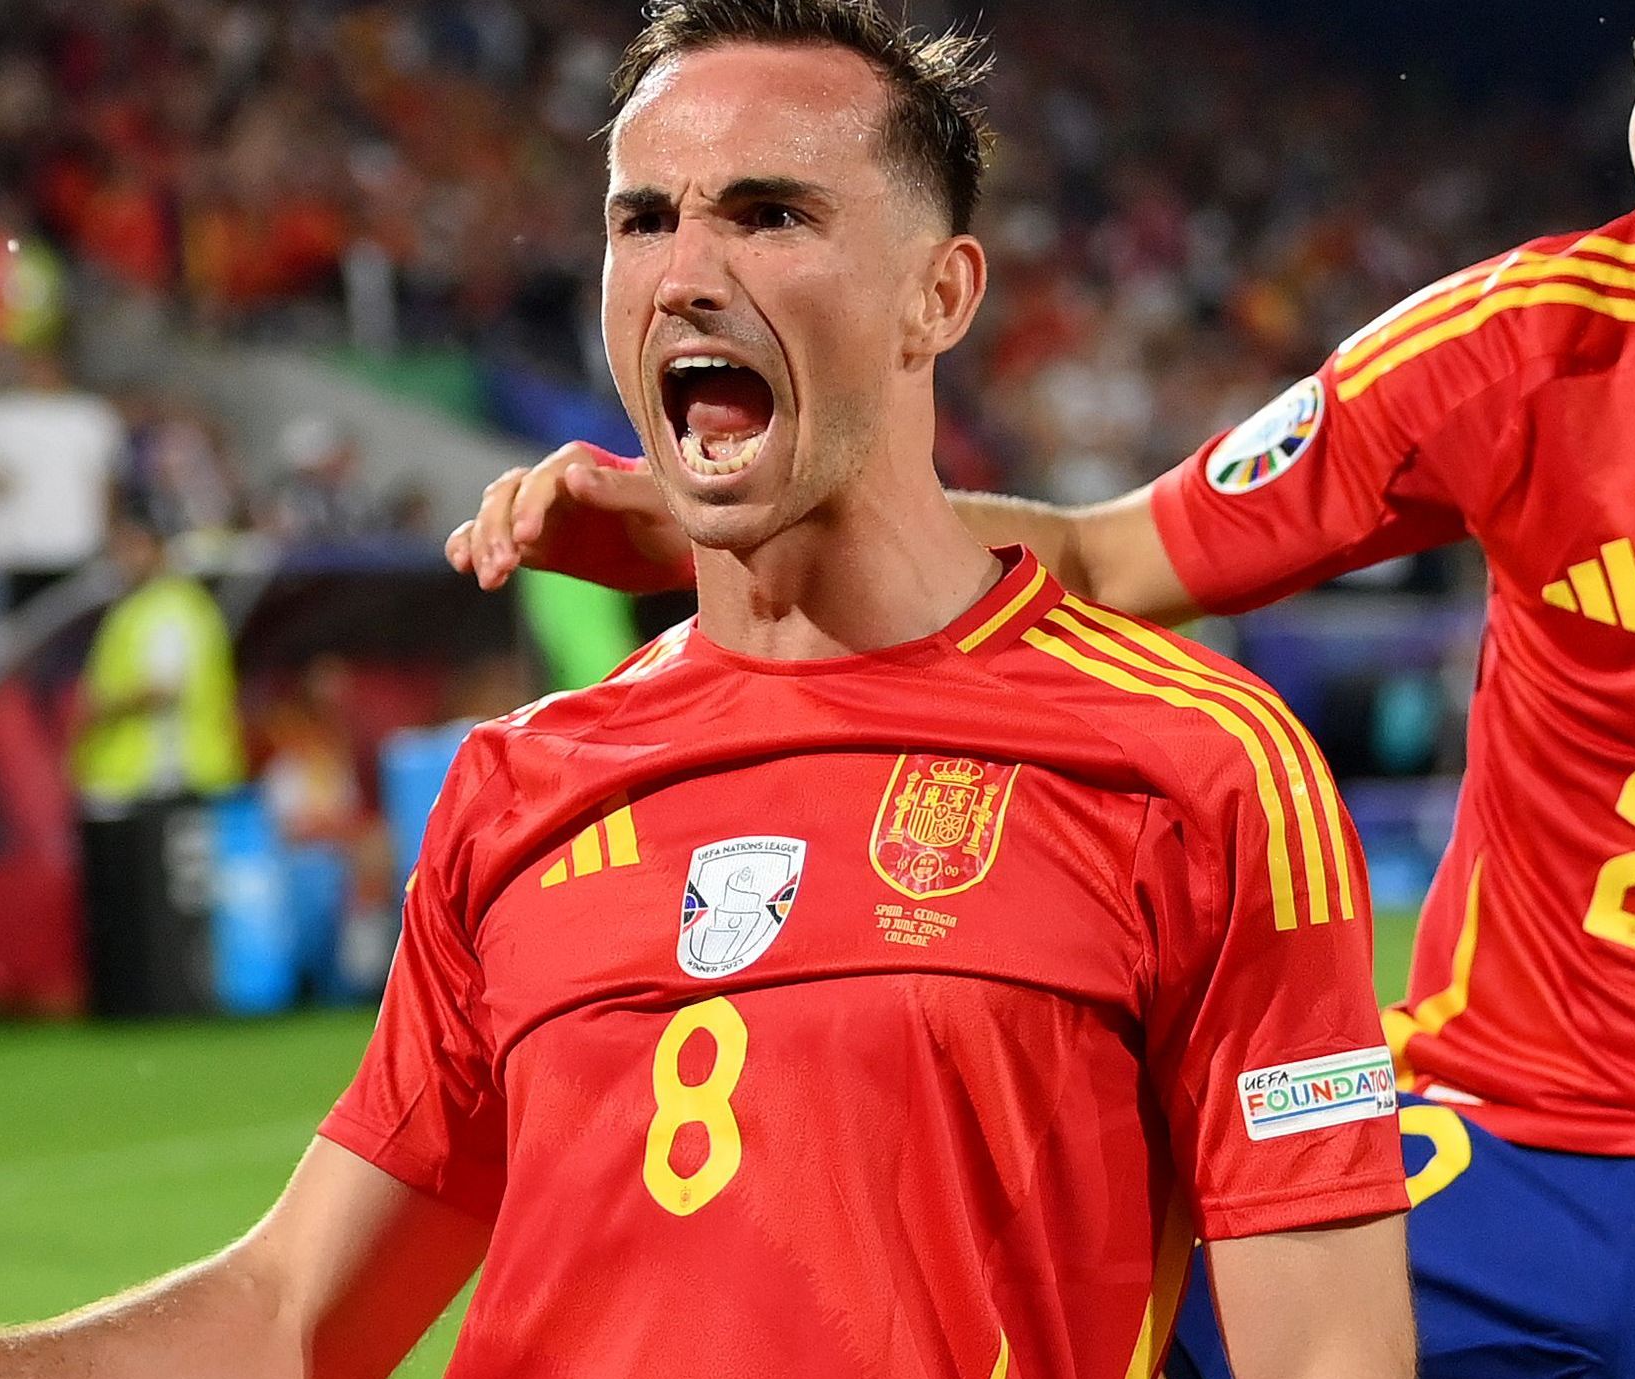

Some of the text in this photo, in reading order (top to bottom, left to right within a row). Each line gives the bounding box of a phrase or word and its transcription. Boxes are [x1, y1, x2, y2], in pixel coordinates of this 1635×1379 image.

[698, 841, 800, 860] UEFA NATIONS LEAGUE
[873, 904, 904, 918] SPAIN
[913, 907, 958, 928] GEORGIA
[876, 917, 947, 939] 30 JUNE 2024
[884, 931, 931, 947] COLOGNE
[686, 958, 718, 972] WINNER
[1244, 1070, 1290, 1091] UEFA
[1247, 1067, 1394, 1115] FOUNDATION
[641, 995, 750, 1217] 8
